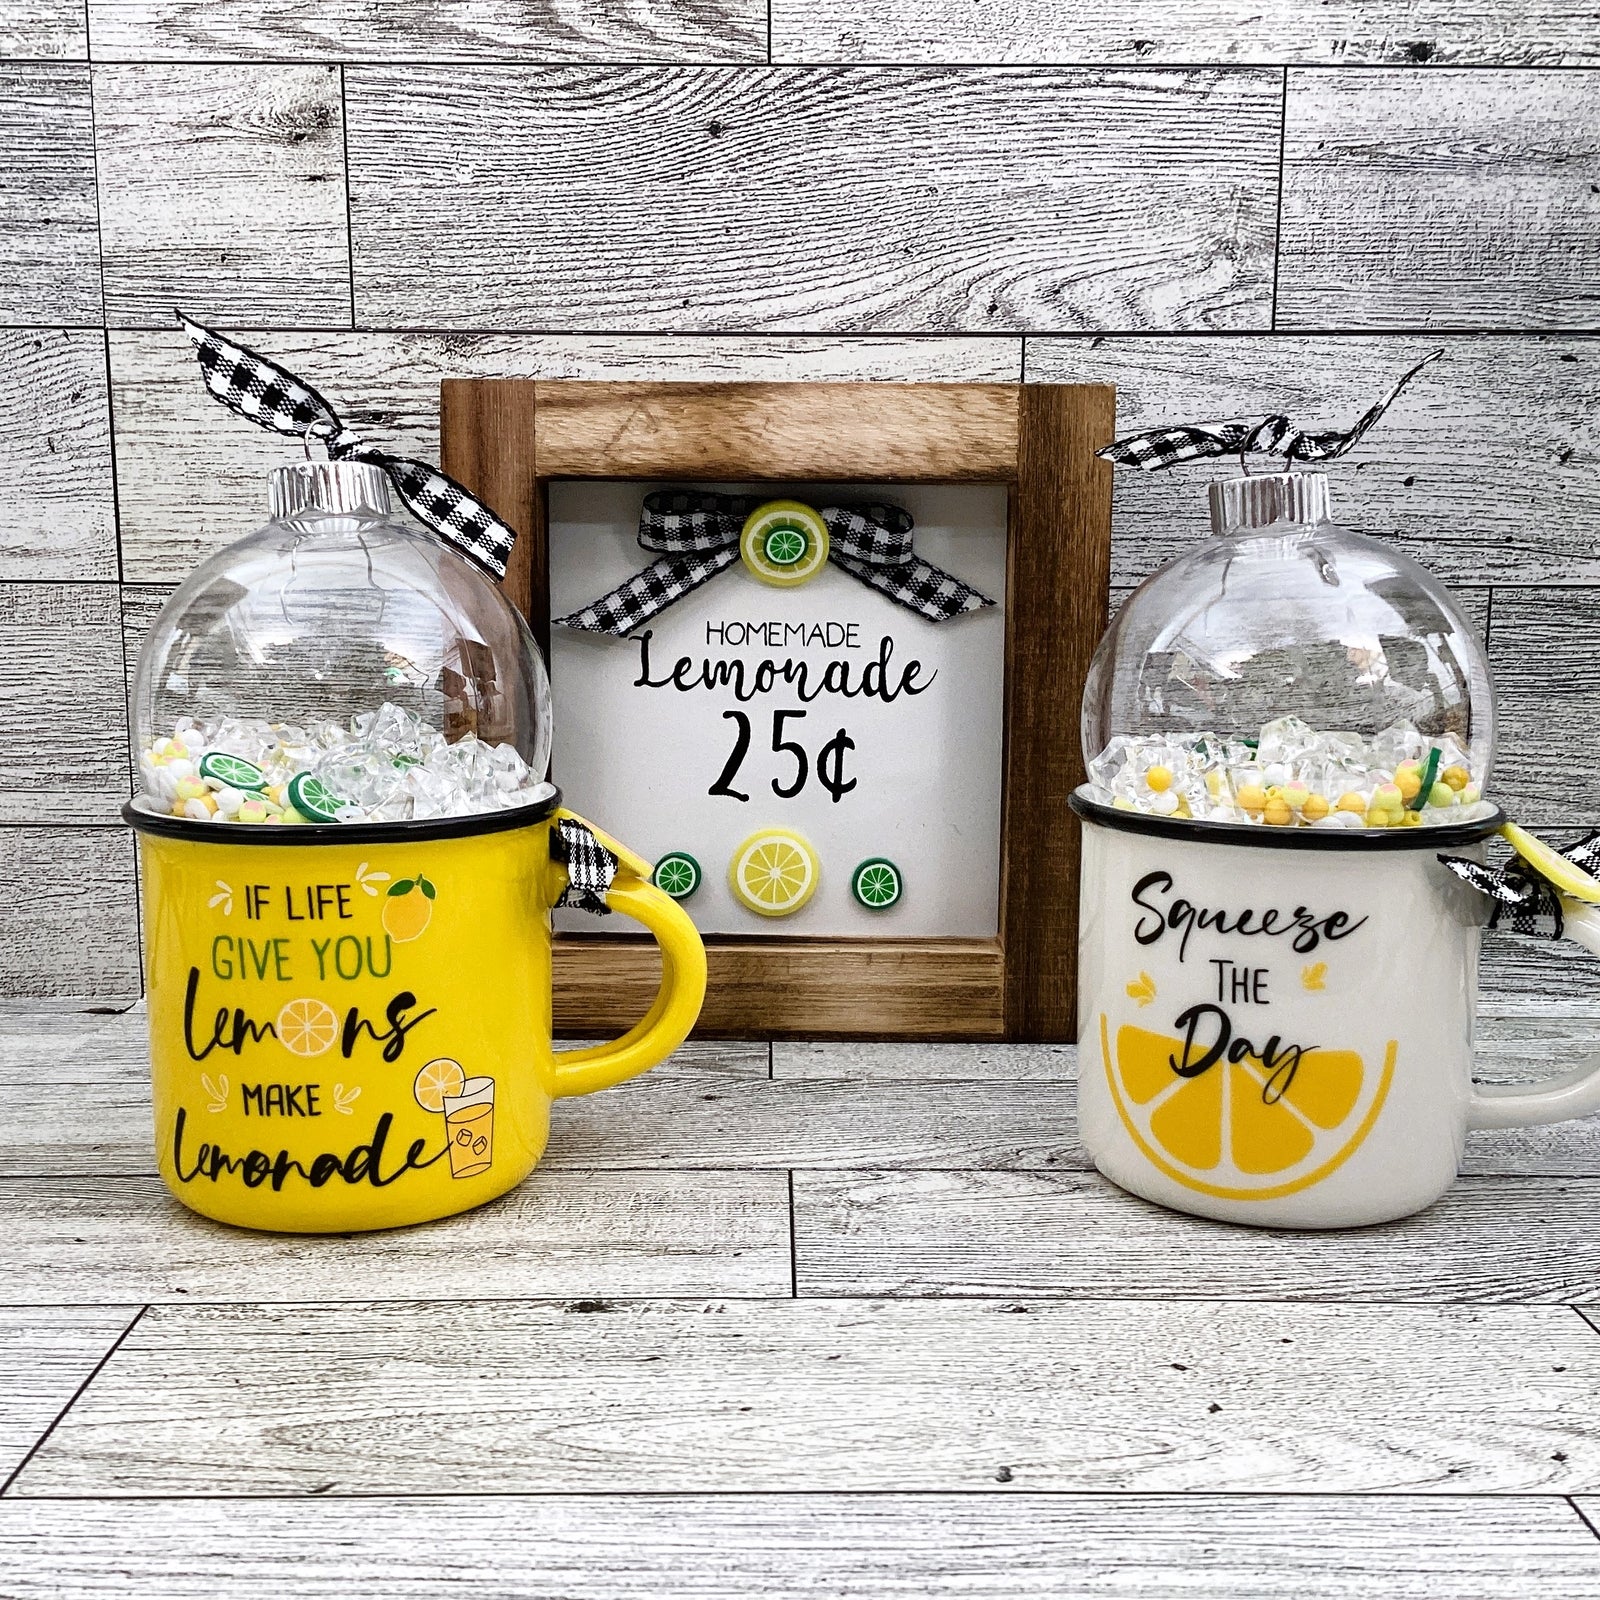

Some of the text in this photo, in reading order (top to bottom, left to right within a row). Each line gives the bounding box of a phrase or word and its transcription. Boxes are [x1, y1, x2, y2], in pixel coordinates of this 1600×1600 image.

[706, 620, 861, 648] HOMEMADE
[628, 629, 938, 703] Lemonade
[708, 709, 857, 803] 25¢
[245, 884, 354, 920] IF LIFE
[1131, 870, 1369, 963] Squeeze
[212, 935, 393, 981] GIVE YOU
[1209, 959, 1270, 1004] THE
[1169, 1003, 1321, 1105] Day
[241, 1083, 322, 1117] MAKE
